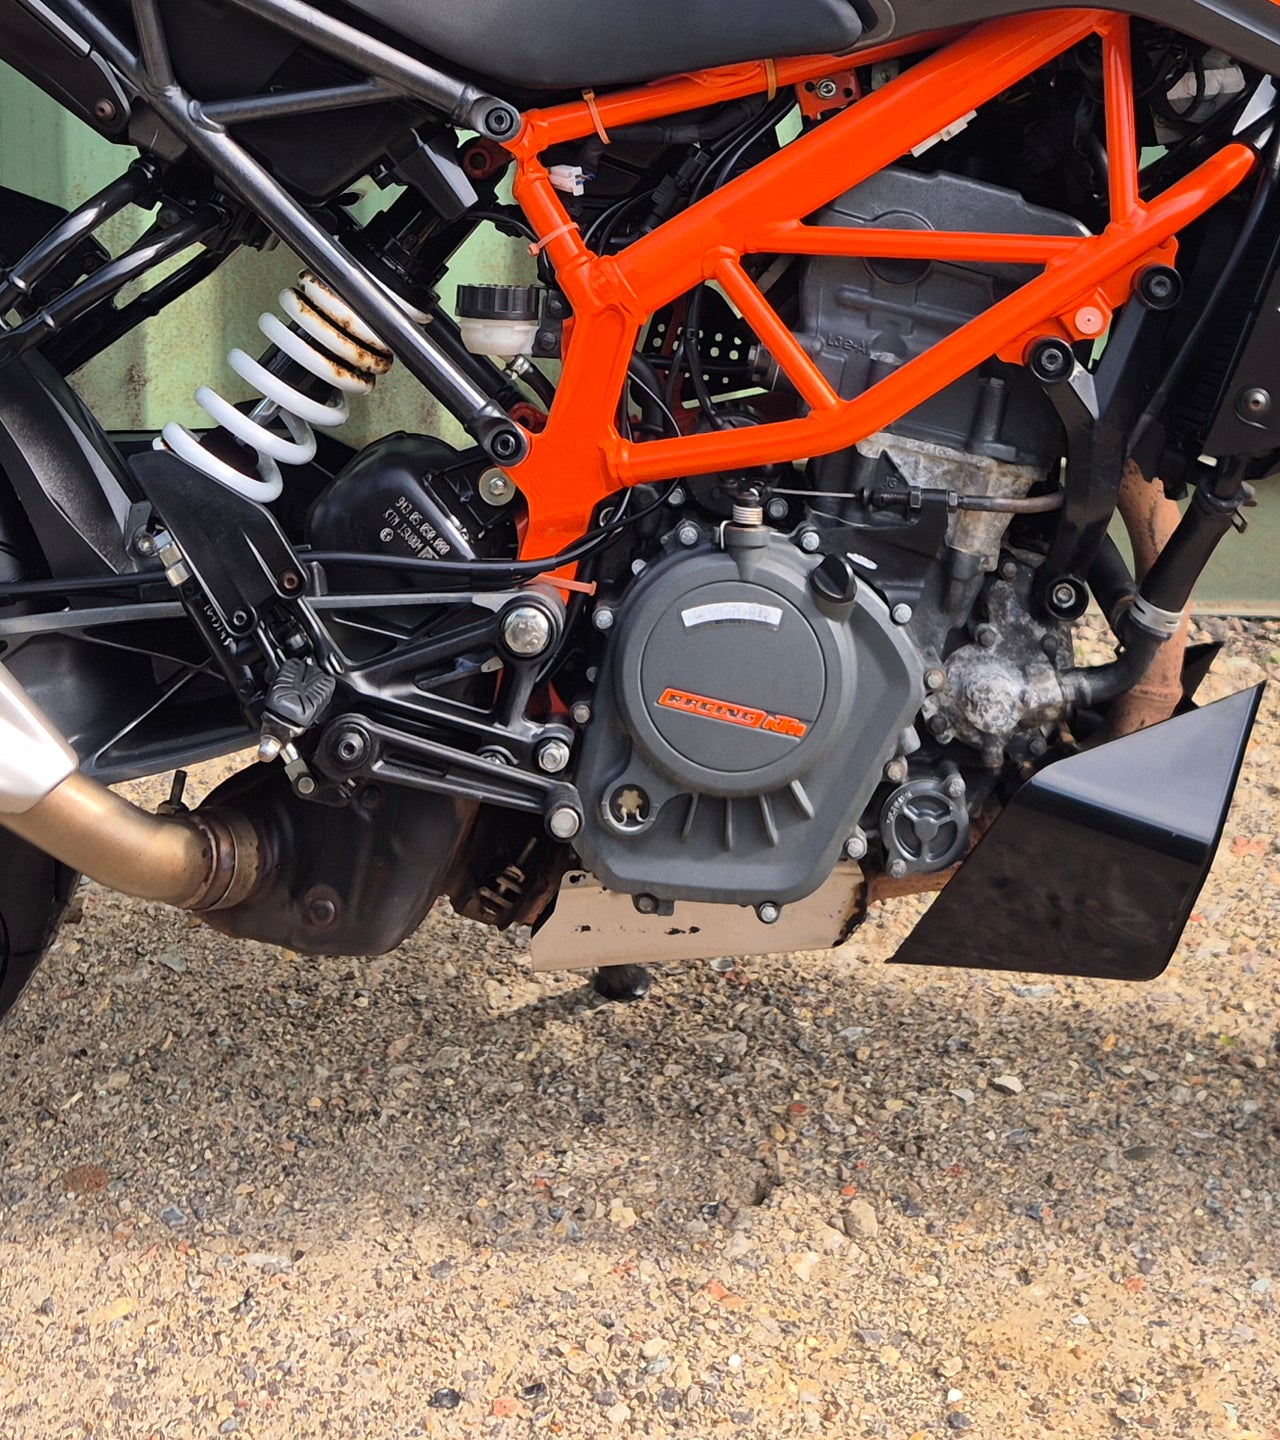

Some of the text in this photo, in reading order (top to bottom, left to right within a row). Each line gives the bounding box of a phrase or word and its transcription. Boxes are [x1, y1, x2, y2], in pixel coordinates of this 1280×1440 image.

[382, 507, 400, 527] KTM
[667, 694, 808, 738] RACING KTM
